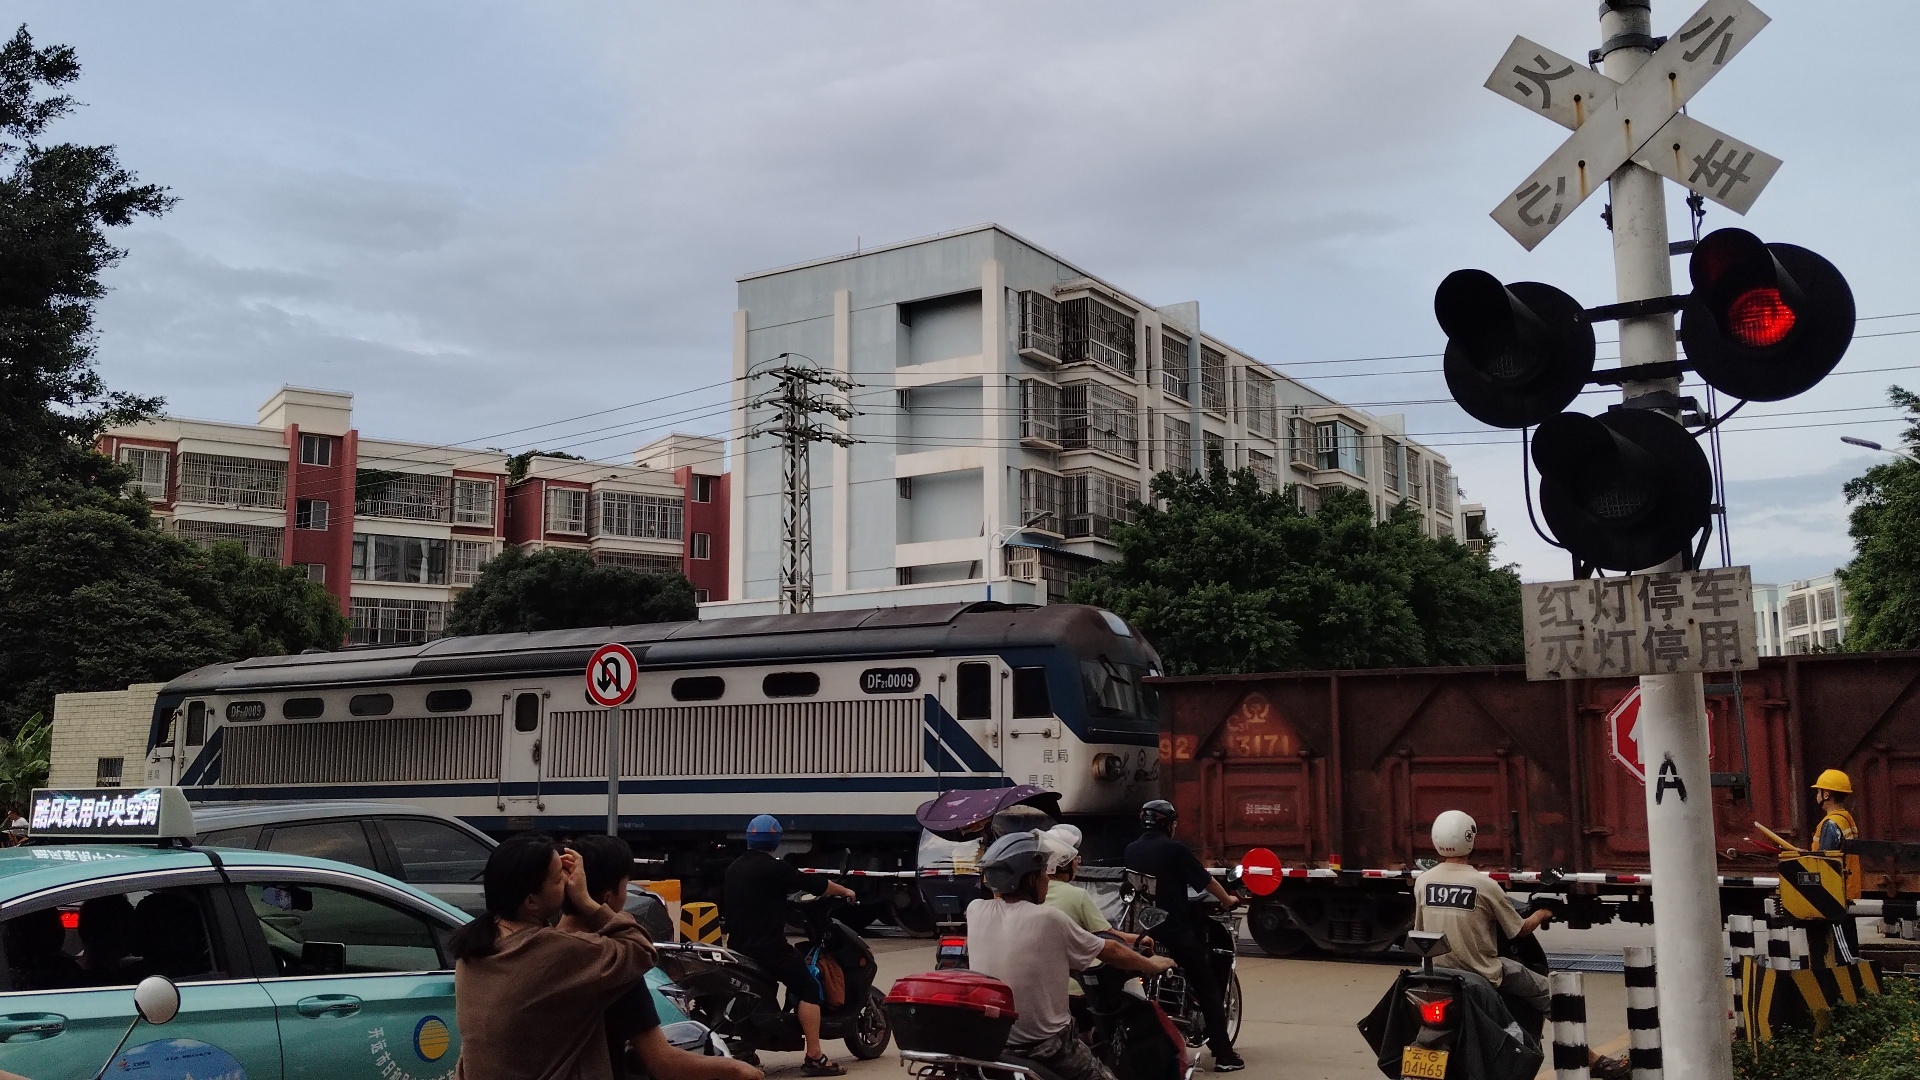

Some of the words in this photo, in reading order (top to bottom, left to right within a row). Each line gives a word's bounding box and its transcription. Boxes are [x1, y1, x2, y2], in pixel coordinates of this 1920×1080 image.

[1536, 569, 1740, 628] 红灯停车
[1540, 620, 1742, 678] 灭灯停用
[1655, 756, 1688, 805] A
[32, 794, 160, 829] 酷风家用中央空调
[1428, 886, 1473, 906] 1977
[1403, 1060, 1444, 1078] 04H65
